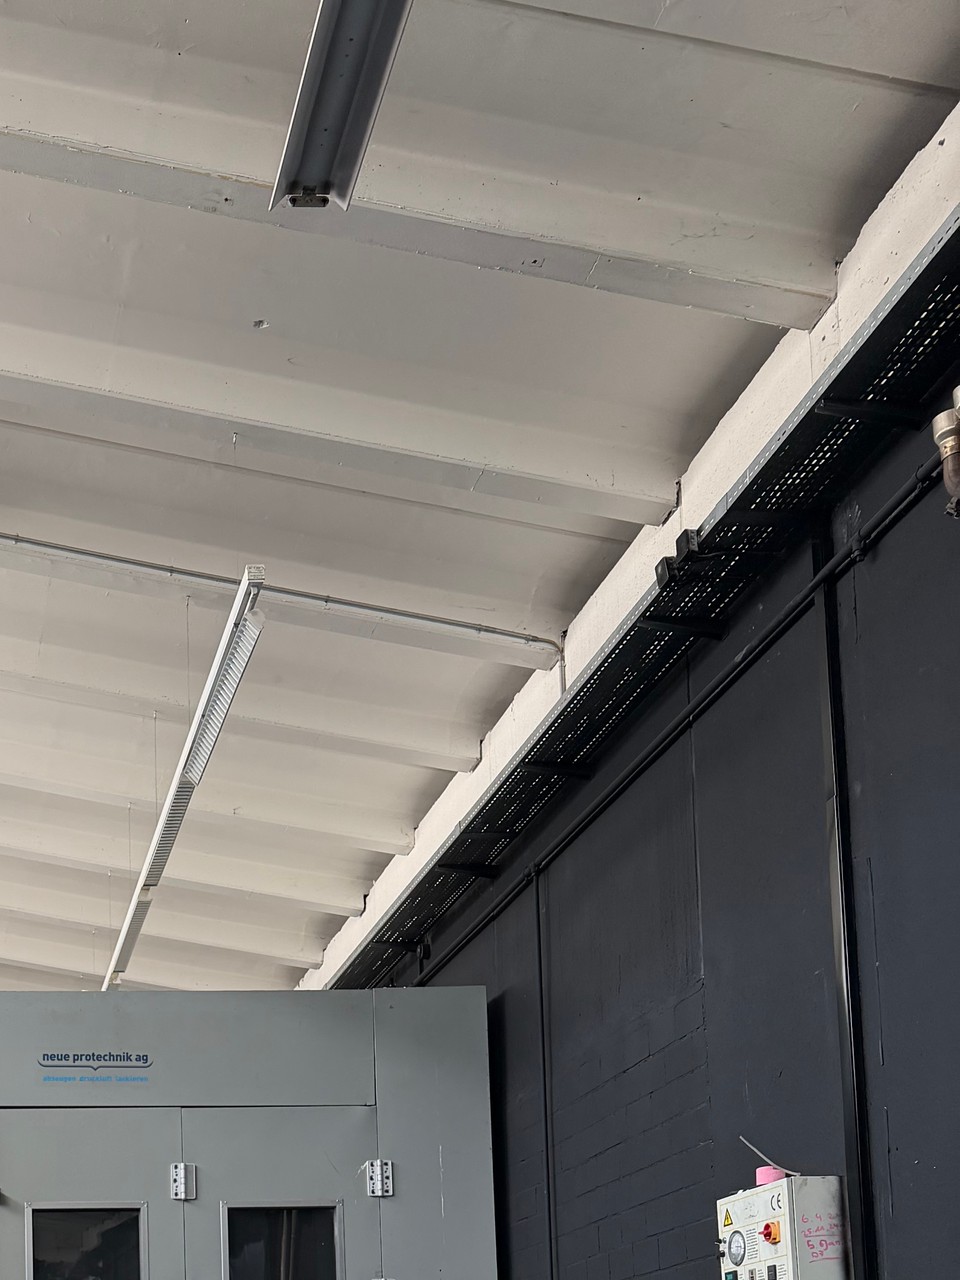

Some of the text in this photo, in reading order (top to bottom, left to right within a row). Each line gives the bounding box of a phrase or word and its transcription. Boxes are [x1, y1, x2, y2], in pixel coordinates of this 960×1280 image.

[42, 1052, 149, 1064] neue protechnik ag
[770, 1192, 783, 1212] CE
